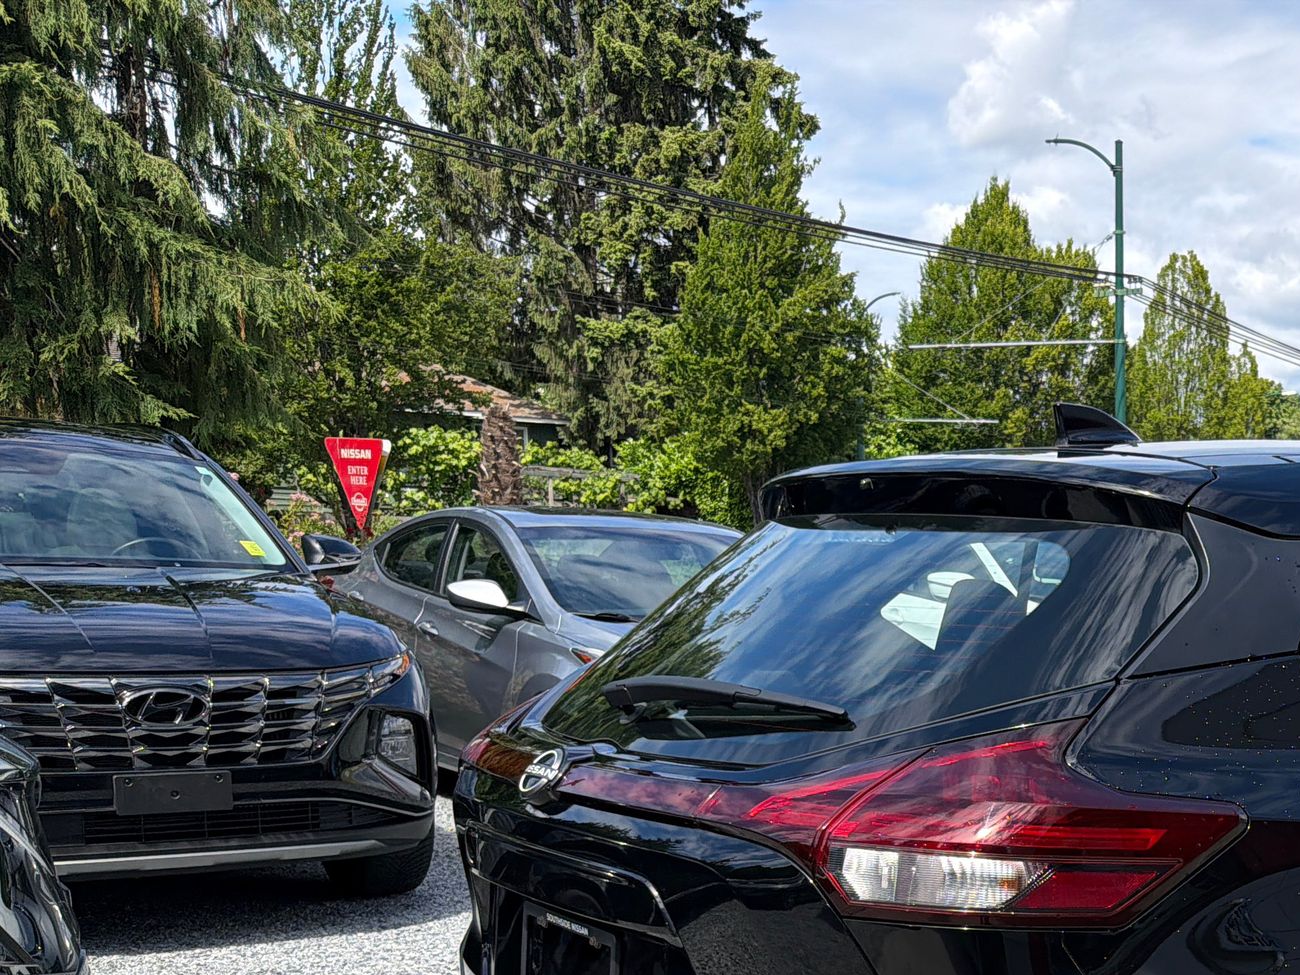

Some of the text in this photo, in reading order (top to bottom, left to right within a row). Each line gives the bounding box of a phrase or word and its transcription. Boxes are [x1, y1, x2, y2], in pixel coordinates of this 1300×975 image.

[340, 448, 372, 459] NISSAN
[347, 465, 369, 475] ENTER
[350, 475, 368, 485] HERE
[526, 764, 559, 780] SSAN
